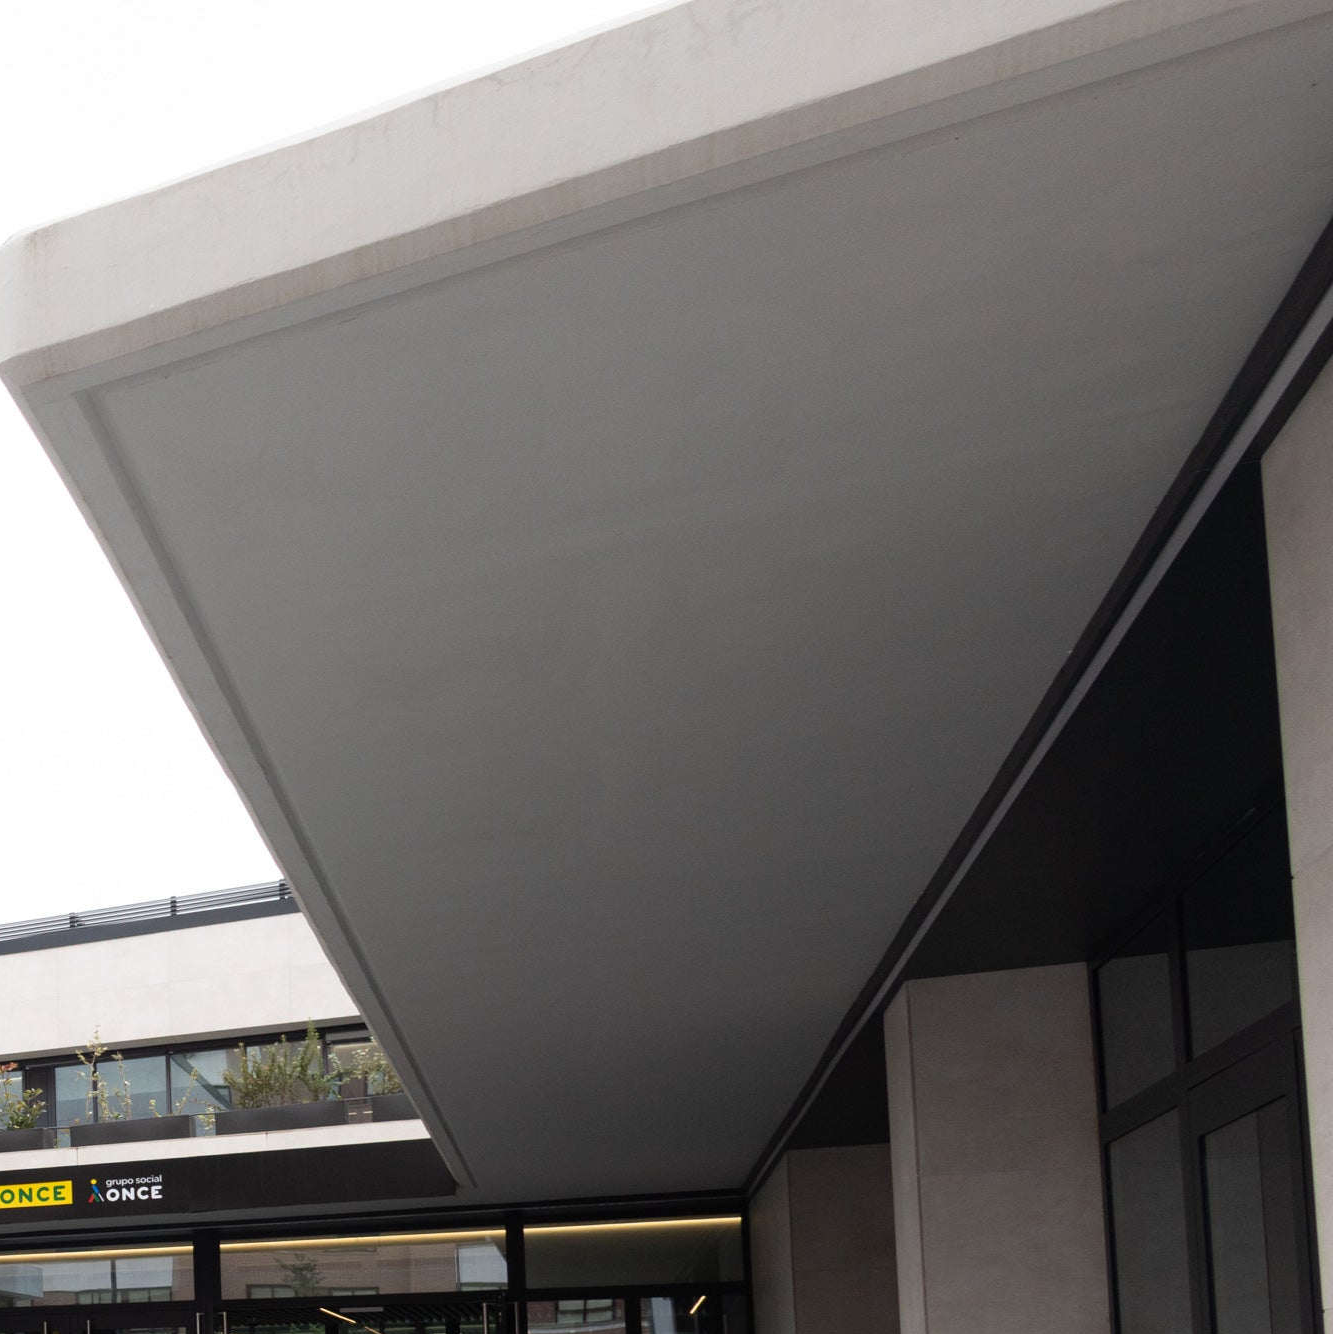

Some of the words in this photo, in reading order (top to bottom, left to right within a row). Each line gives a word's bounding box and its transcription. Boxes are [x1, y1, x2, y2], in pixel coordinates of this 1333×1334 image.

[105, 1177, 134, 1188] grupo
[135, 1174, 163, 1185] social
[0, 1185, 66, 1205] ONCE
[105, 1185, 163, 1202] ONCE
